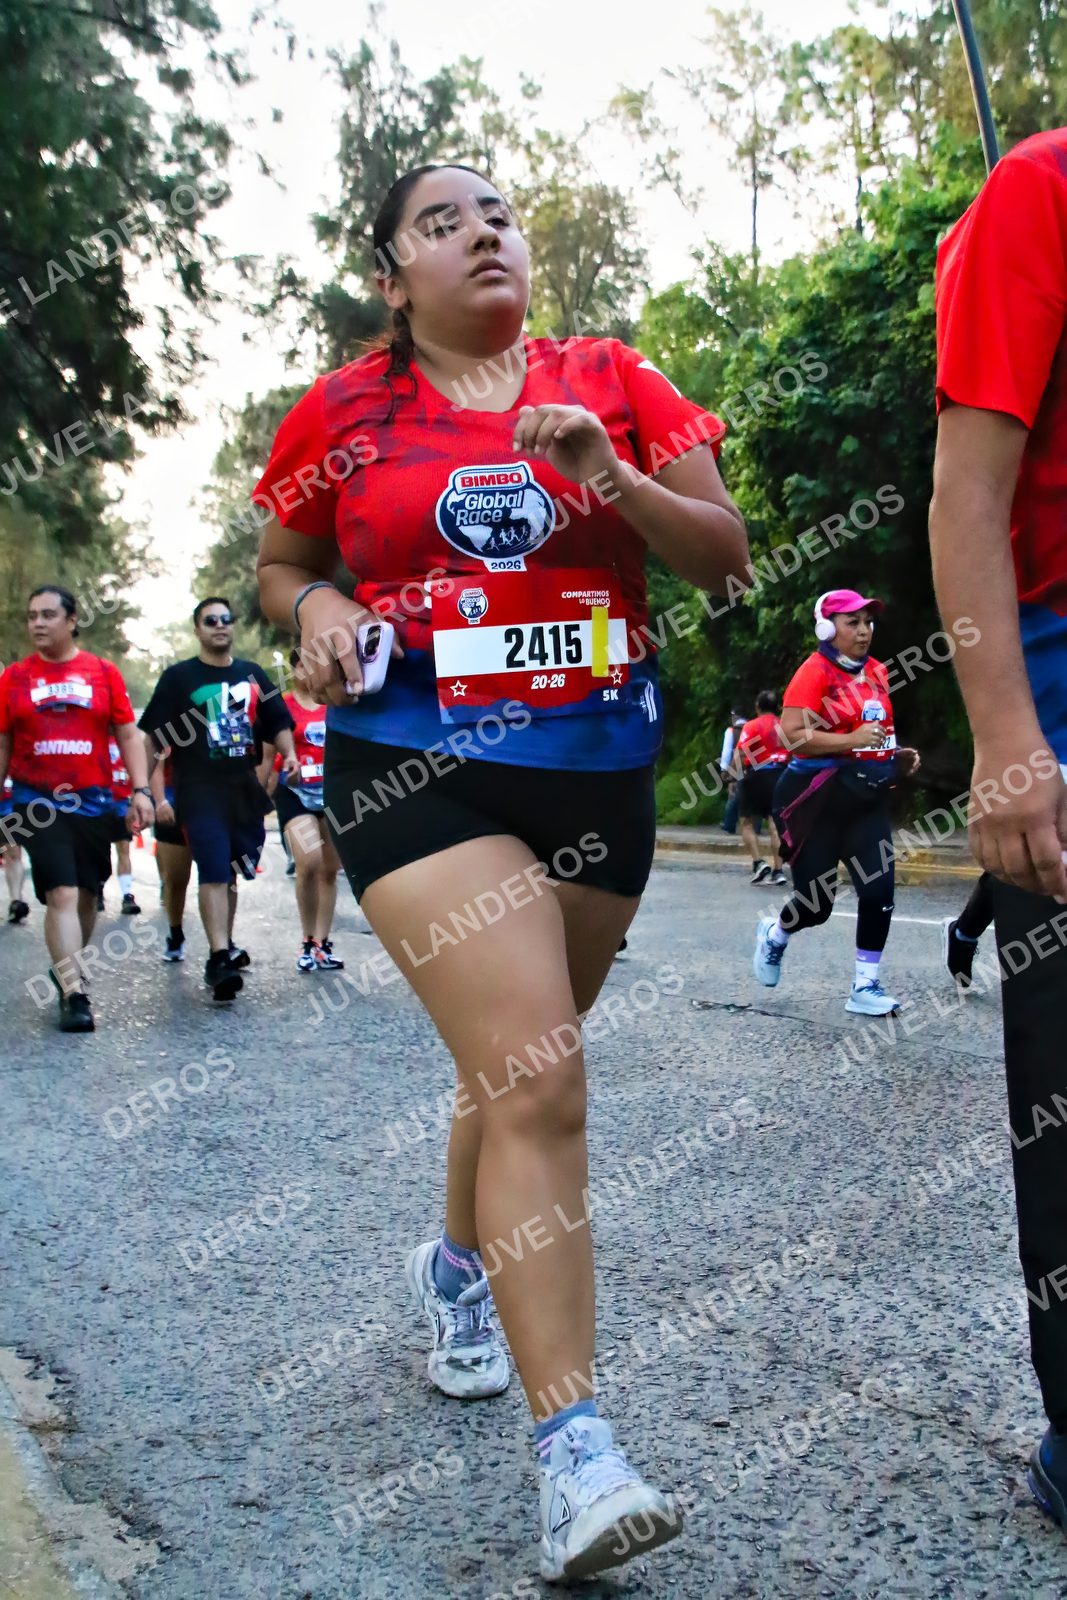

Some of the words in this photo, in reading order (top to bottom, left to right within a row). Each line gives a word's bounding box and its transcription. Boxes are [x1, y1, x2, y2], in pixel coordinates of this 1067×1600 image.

[461, 472, 522, 488] BIMBO
[465, 490, 523, 509] Global
[456, 508, 503, 526] Race
[491, 560, 522, 571] 2026
[561, 590, 609, 599] COMPARTIMOS
[504, 624, 583, 668] 2415
[603, 689, 619, 701] 5K
[33, 740, 93, 755] SANTIAGO
